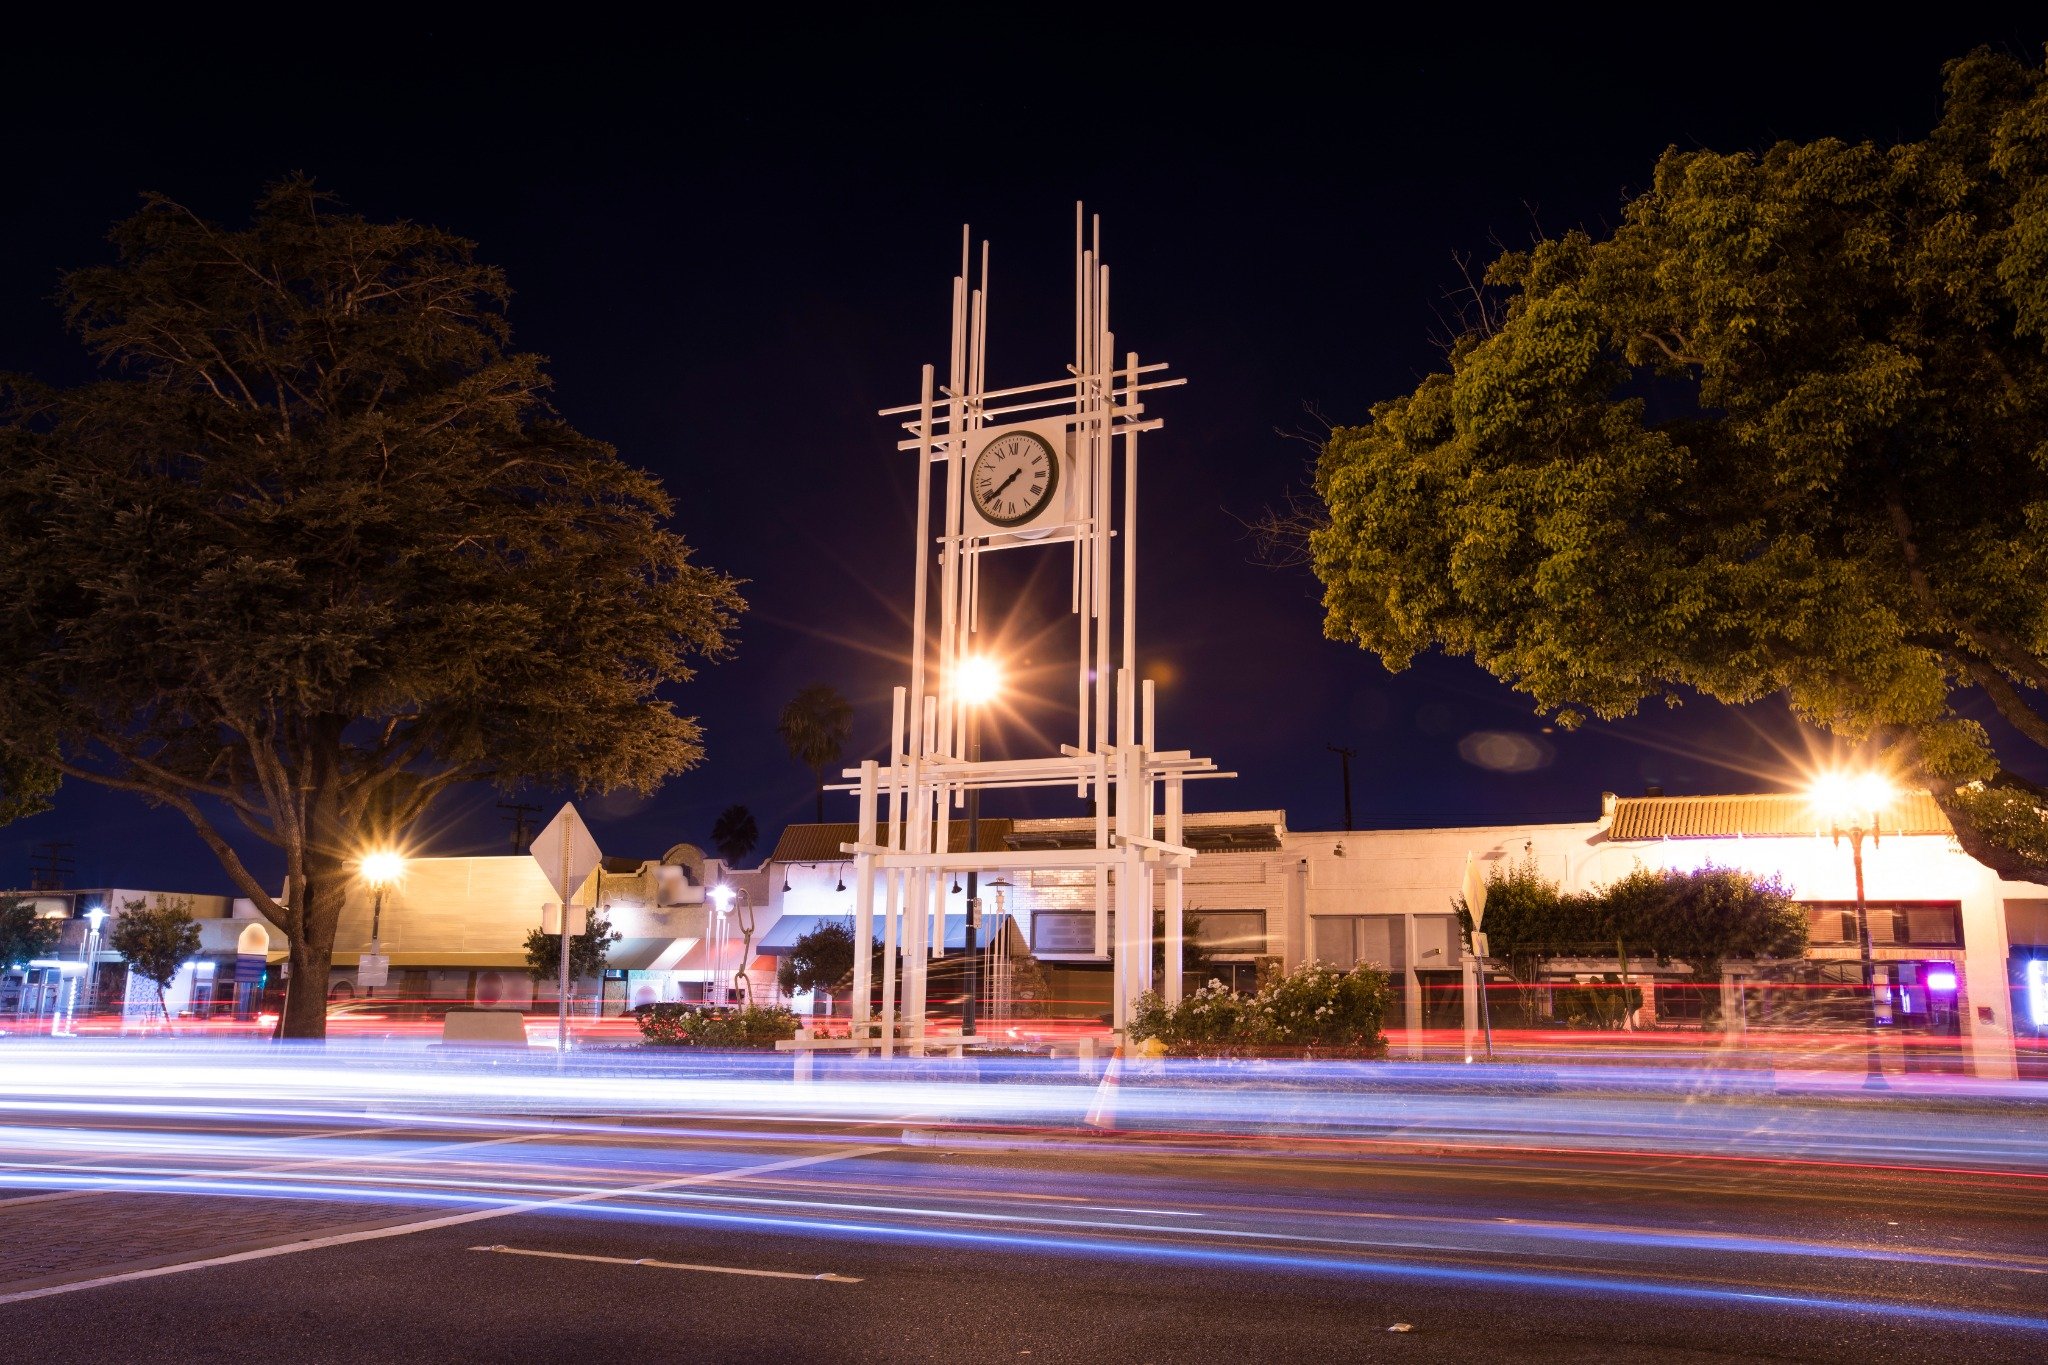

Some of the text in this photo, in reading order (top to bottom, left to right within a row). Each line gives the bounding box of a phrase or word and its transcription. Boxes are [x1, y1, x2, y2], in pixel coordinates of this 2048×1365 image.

[1031, 455, 1043, 465] II
[984, 461, 996, 472] X
[1034, 470, 1046, 478] III
